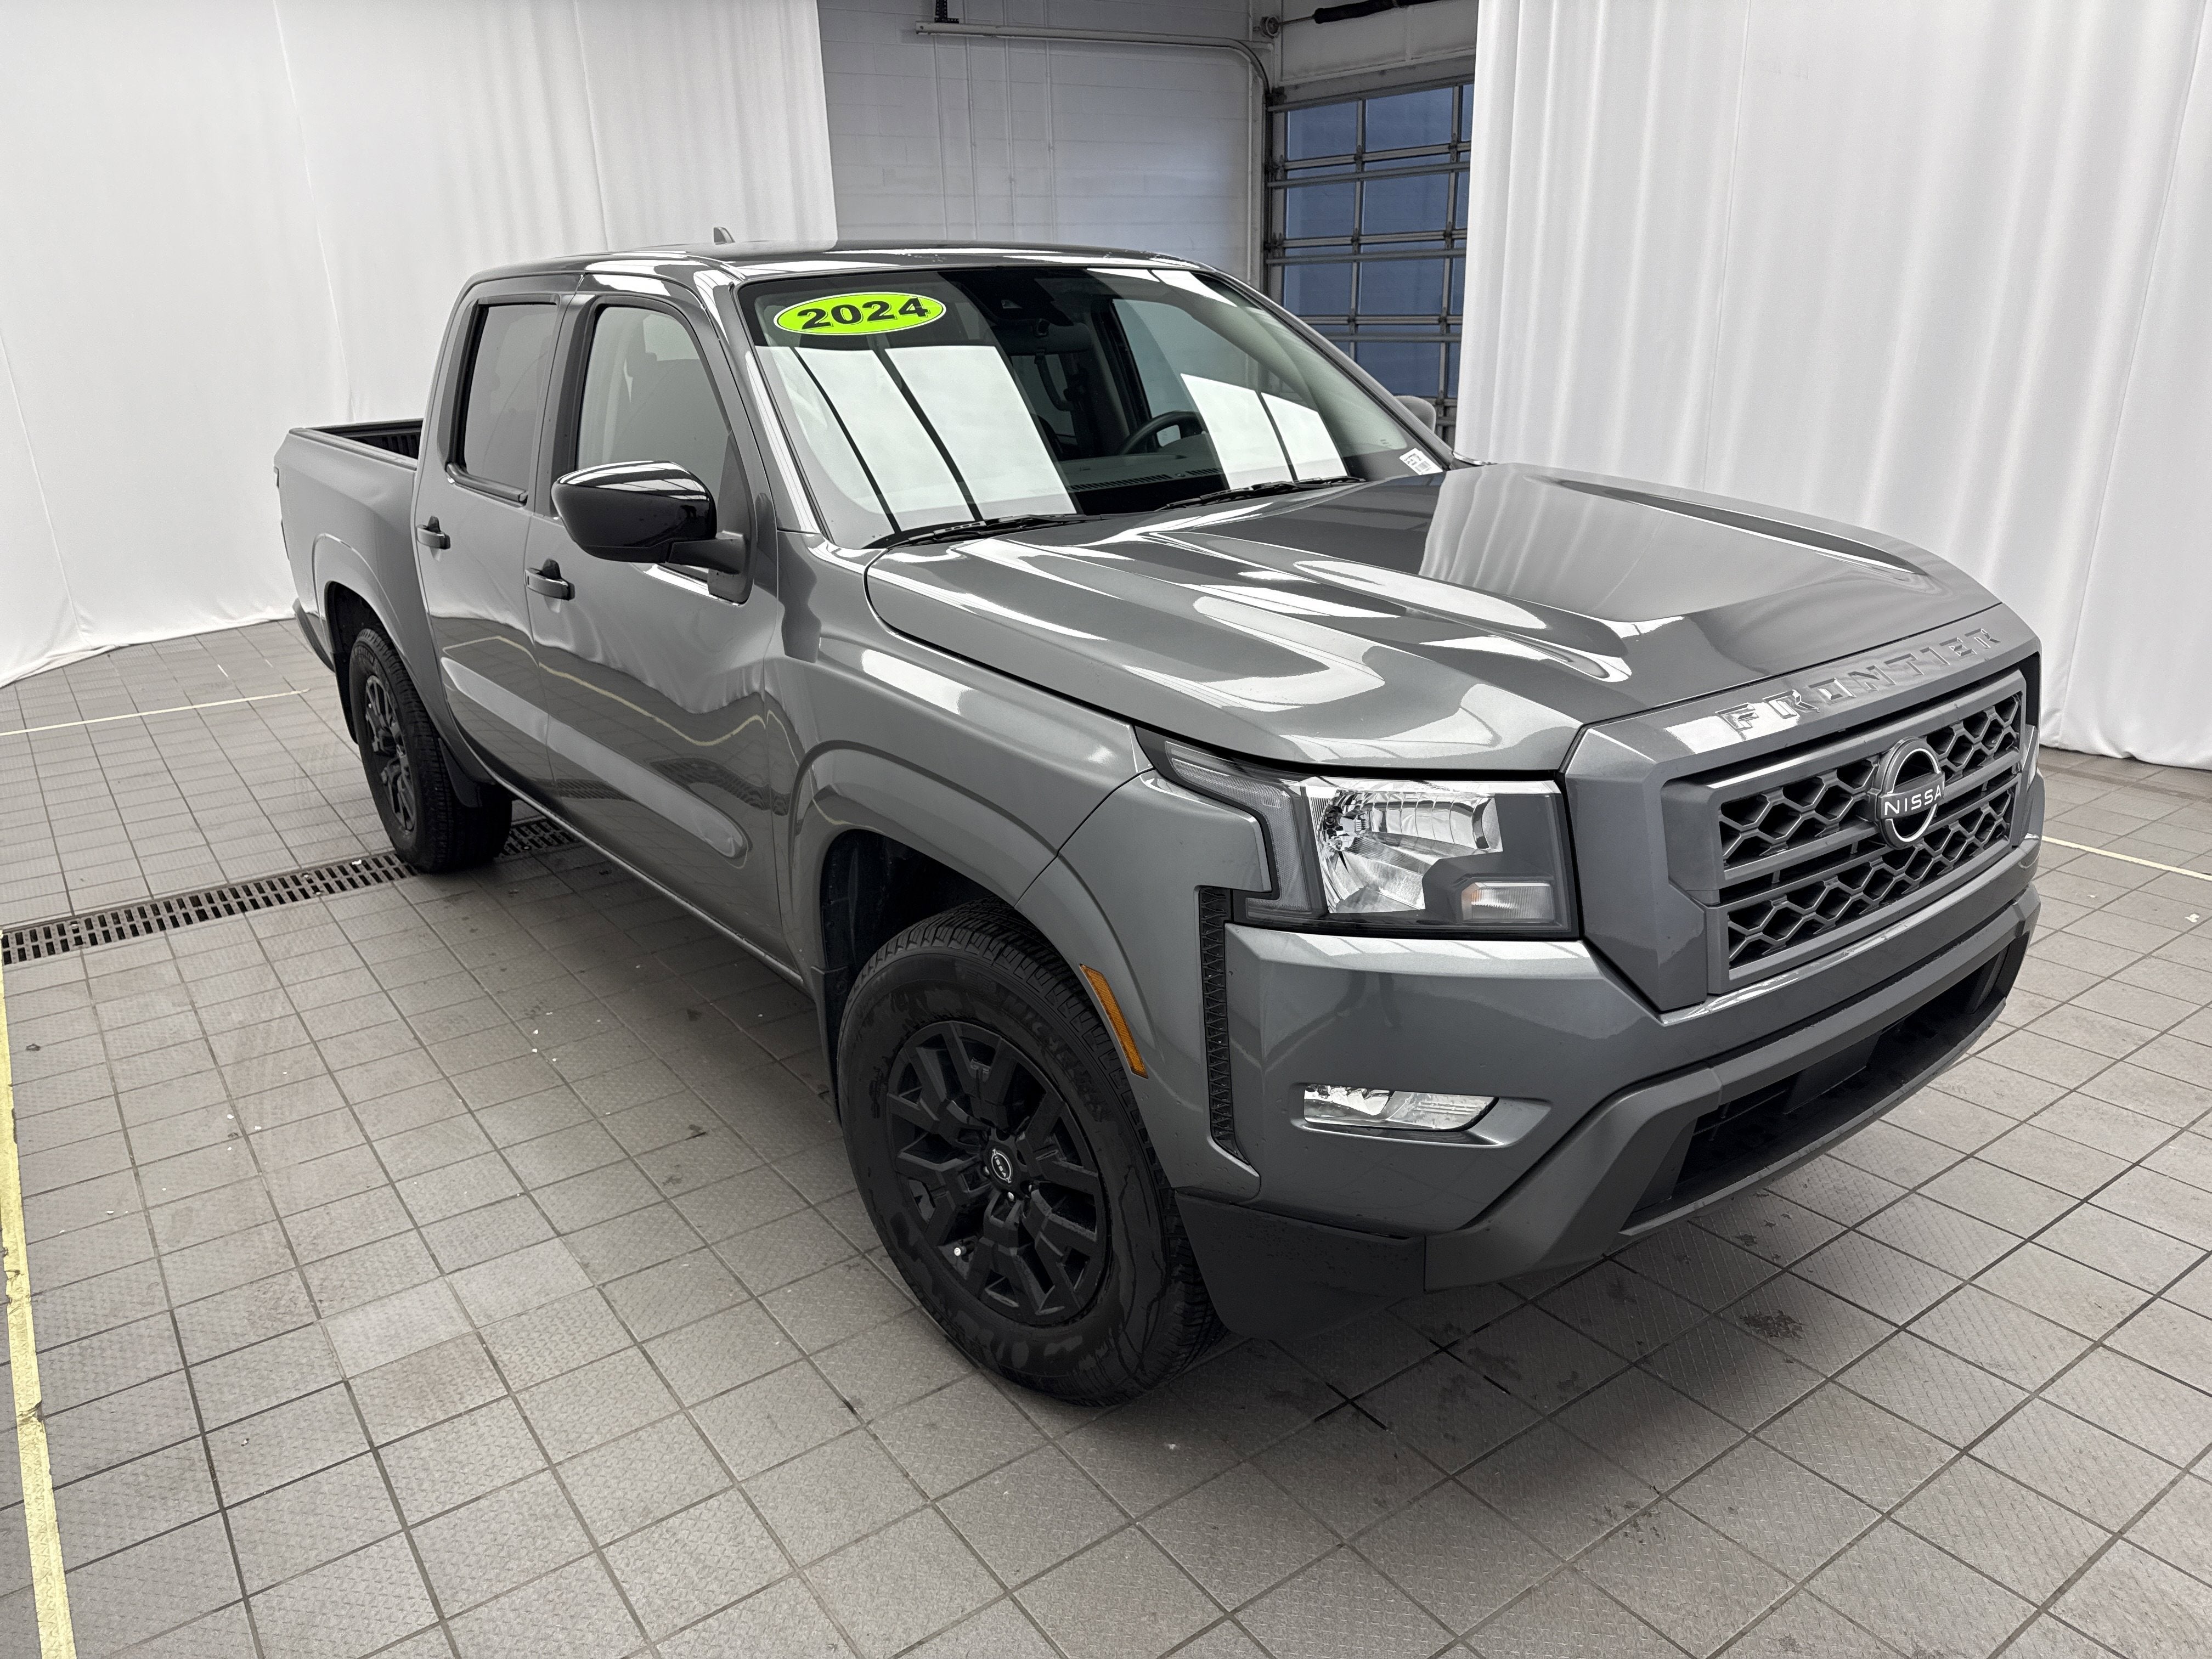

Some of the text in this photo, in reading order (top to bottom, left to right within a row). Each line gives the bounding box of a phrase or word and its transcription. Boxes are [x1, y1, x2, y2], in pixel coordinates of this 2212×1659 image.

[797, 297, 930, 330] 2024
[1715, 628, 2001, 740] FRONTIER
[1884, 780, 1945, 816] NISSA
